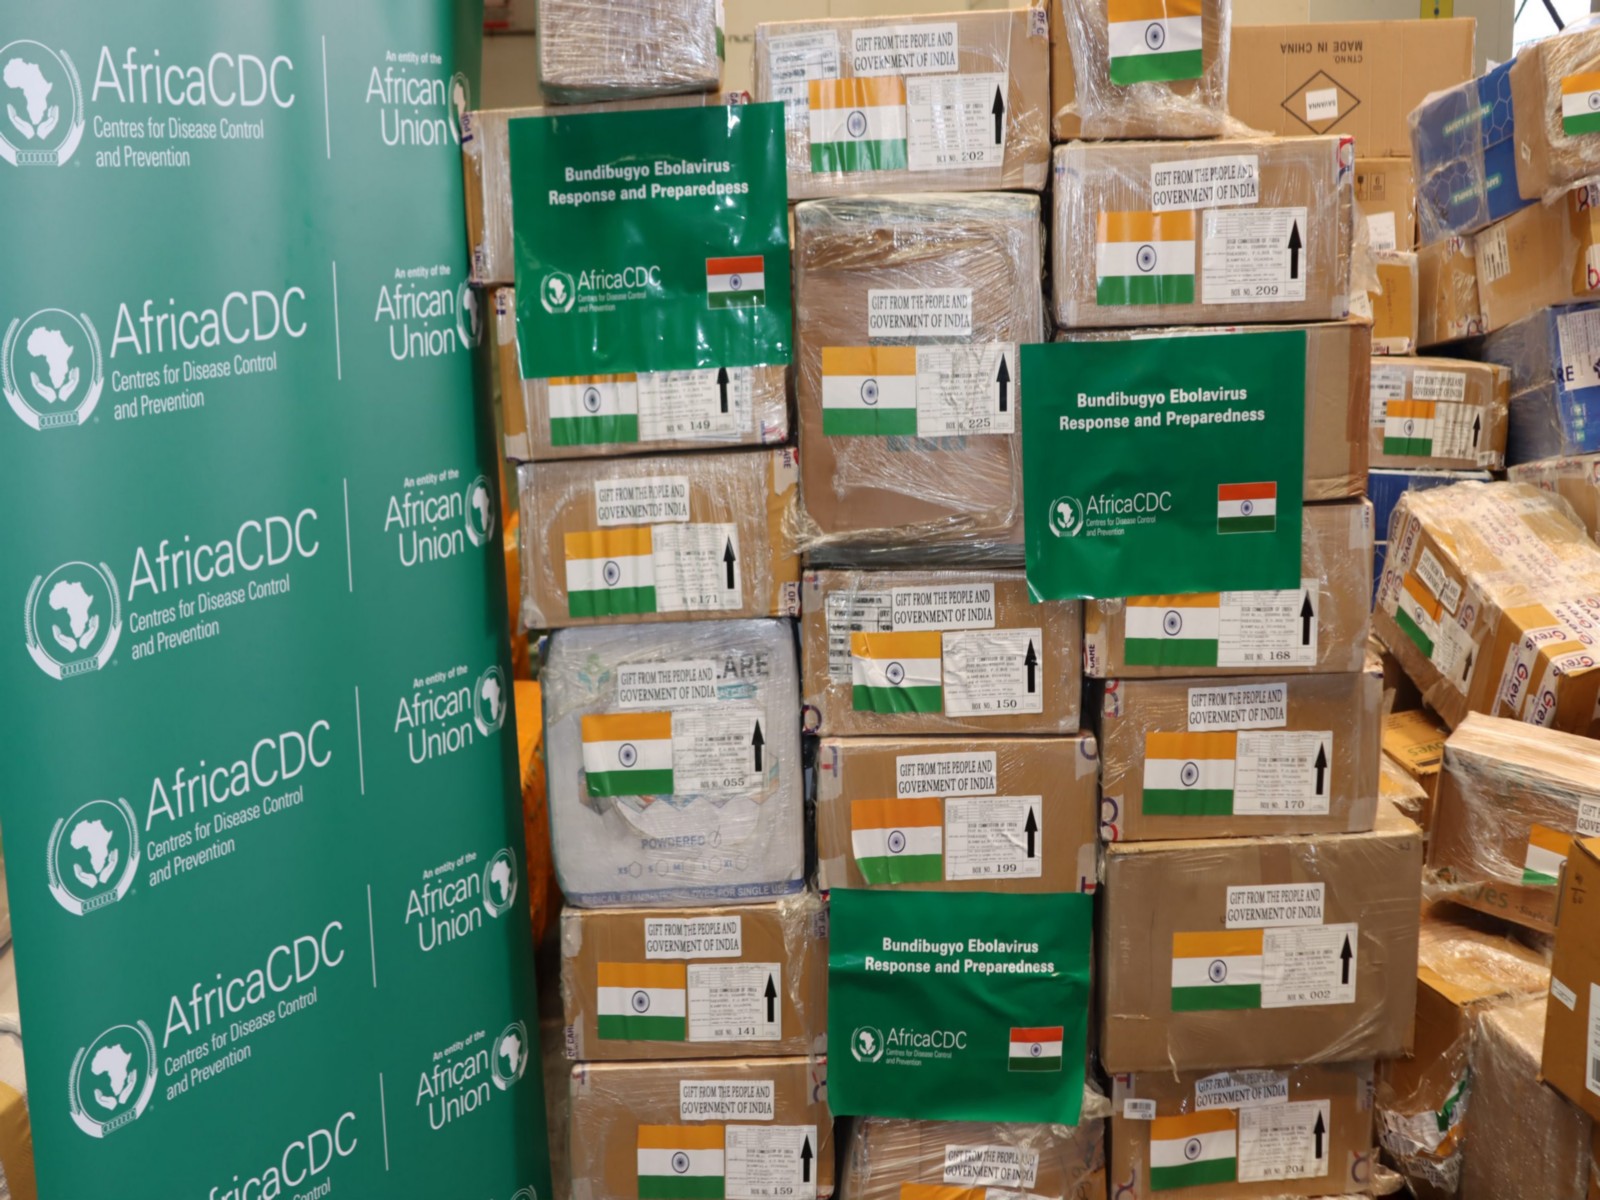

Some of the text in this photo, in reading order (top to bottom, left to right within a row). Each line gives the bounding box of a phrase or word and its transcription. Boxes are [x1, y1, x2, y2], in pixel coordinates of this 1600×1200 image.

[386, 50, 440, 63] An entity of the
[1280, 40, 1362, 54] MADE IN CHINA
[92, 46, 294, 107] AfricaCDC
[366, 66, 444, 104] African
[1308, 100, 1336, 110] SAVANNA
[93, 115, 263, 138] Centres for Disease Control
[381, 108, 446, 145] Union
[96, 146, 189, 166] and Prevention
[962, 151, 983, 160] 202
[565, 159, 729, 181] Bundibugyo Ebolavirus
[549, 180, 748, 205] Response and Preparedness
[395, 265, 449, 277] An entity of the
[577, 265, 662, 289] AfricaCDC
[1256, 286, 1277, 294] 209
[375, 286, 452, 320] African
[110, 287, 306, 357] AfricaCDC
[390, 323, 454, 360] Union
[112, 351, 276, 391] Centres for Disease Control
[114, 392, 203, 419] and Prevention
[1077, 386, 1246, 407] Bundibugyo Ebolavirus
[691, 420, 709, 429] 149
[969, 418, 990, 428] 225
[1060, 408, 1264, 431] Response and Preparedness
[404, 470, 458, 486] An entity of the
[384, 492, 461, 530] African
[1086, 491, 1170, 514] AfricaCDC
[128, 508, 318, 600] AfricaCDC
[399, 529, 463, 566] Union
[129, 574, 289, 632] Centres for Disease Control
[896, 589, 989, 605] GIFT FROM THE PEOPLE AND
[894, 607, 991, 623] GOVERNMENT OF INDIA
[132, 621, 218, 659] and Prevention
[395, 687, 470, 731] African
[1192, 689, 1281, 706] GIFT FROM THE PEOPLE AND
[1189, 707, 1283, 724] GOVERNMENT OF INDIA
[409, 722, 472, 763] Union
[146, 720, 330, 830] AfricaCDC
[900, 759, 991, 776] GIFT FROM THE PEOPLE AND
[723, 777, 744, 786] 055
[898, 776, 994, 793] GOVERNMENT OF INDIA
[405, 873, 479, 923] African
[738, 886, 769, 896] SINGLE
[1230, 888, 1319, 904] GIFT FROM THE PEOPLE AND
[1228, 905, 1320, 921] GOVERNMENT OF INDIA
[418, 907, 480, 950] Union
[649, 922, 735, 935] GIFT FROM THE PEOPLE AND
[647, 938, 739, 952] GOVERNMENT OF INDIA
[883, 937, 1038, 955] Bundibugyo Ebolavirus
[865, 956, 1054, 976] Response and Preparedness
[163, 921, 343, 1047] AfricaCDC
[1310, 990, 1330, 998] 002
[164, 988, 316, 1075] Centres for Disease Control
[886, 1028, 966, 1048] AfricaCDC
[433, 1030, 484, 1060] An entity of the
[167, 1046, 250, 1099] and Prevention
[416, 1050, 487, 1105] African
[429, 1084, 489, 1129] Union
